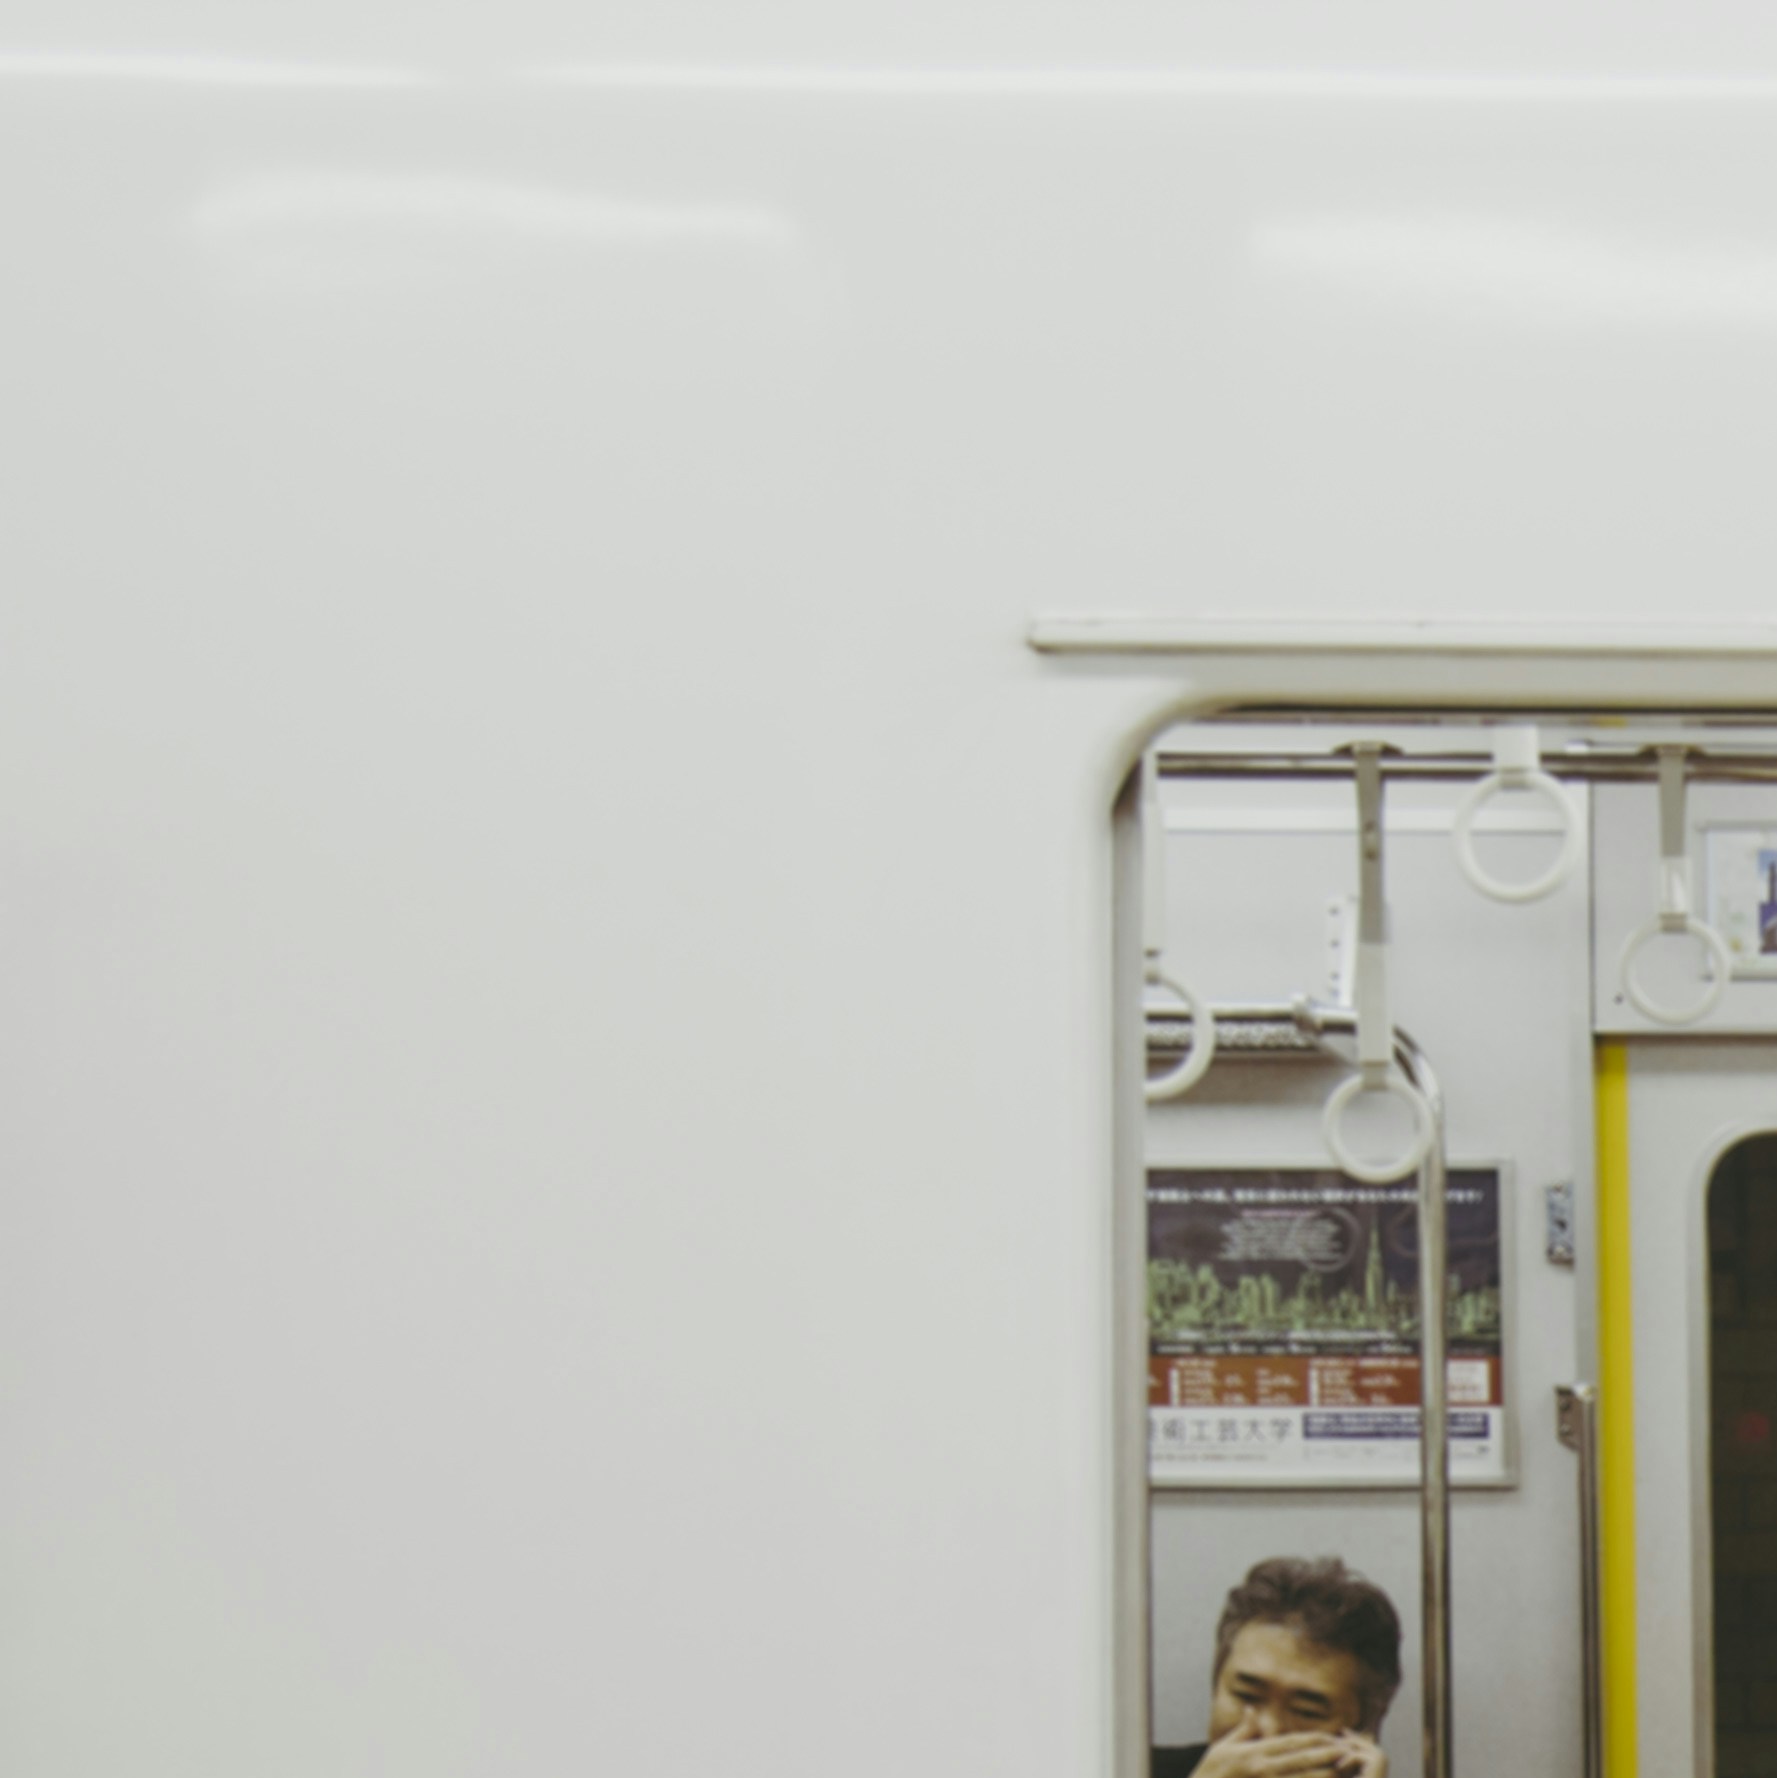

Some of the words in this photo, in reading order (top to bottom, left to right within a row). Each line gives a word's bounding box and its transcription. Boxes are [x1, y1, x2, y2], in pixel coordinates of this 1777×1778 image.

[1148, 1418, 1293, 1444] 術工芸大学
